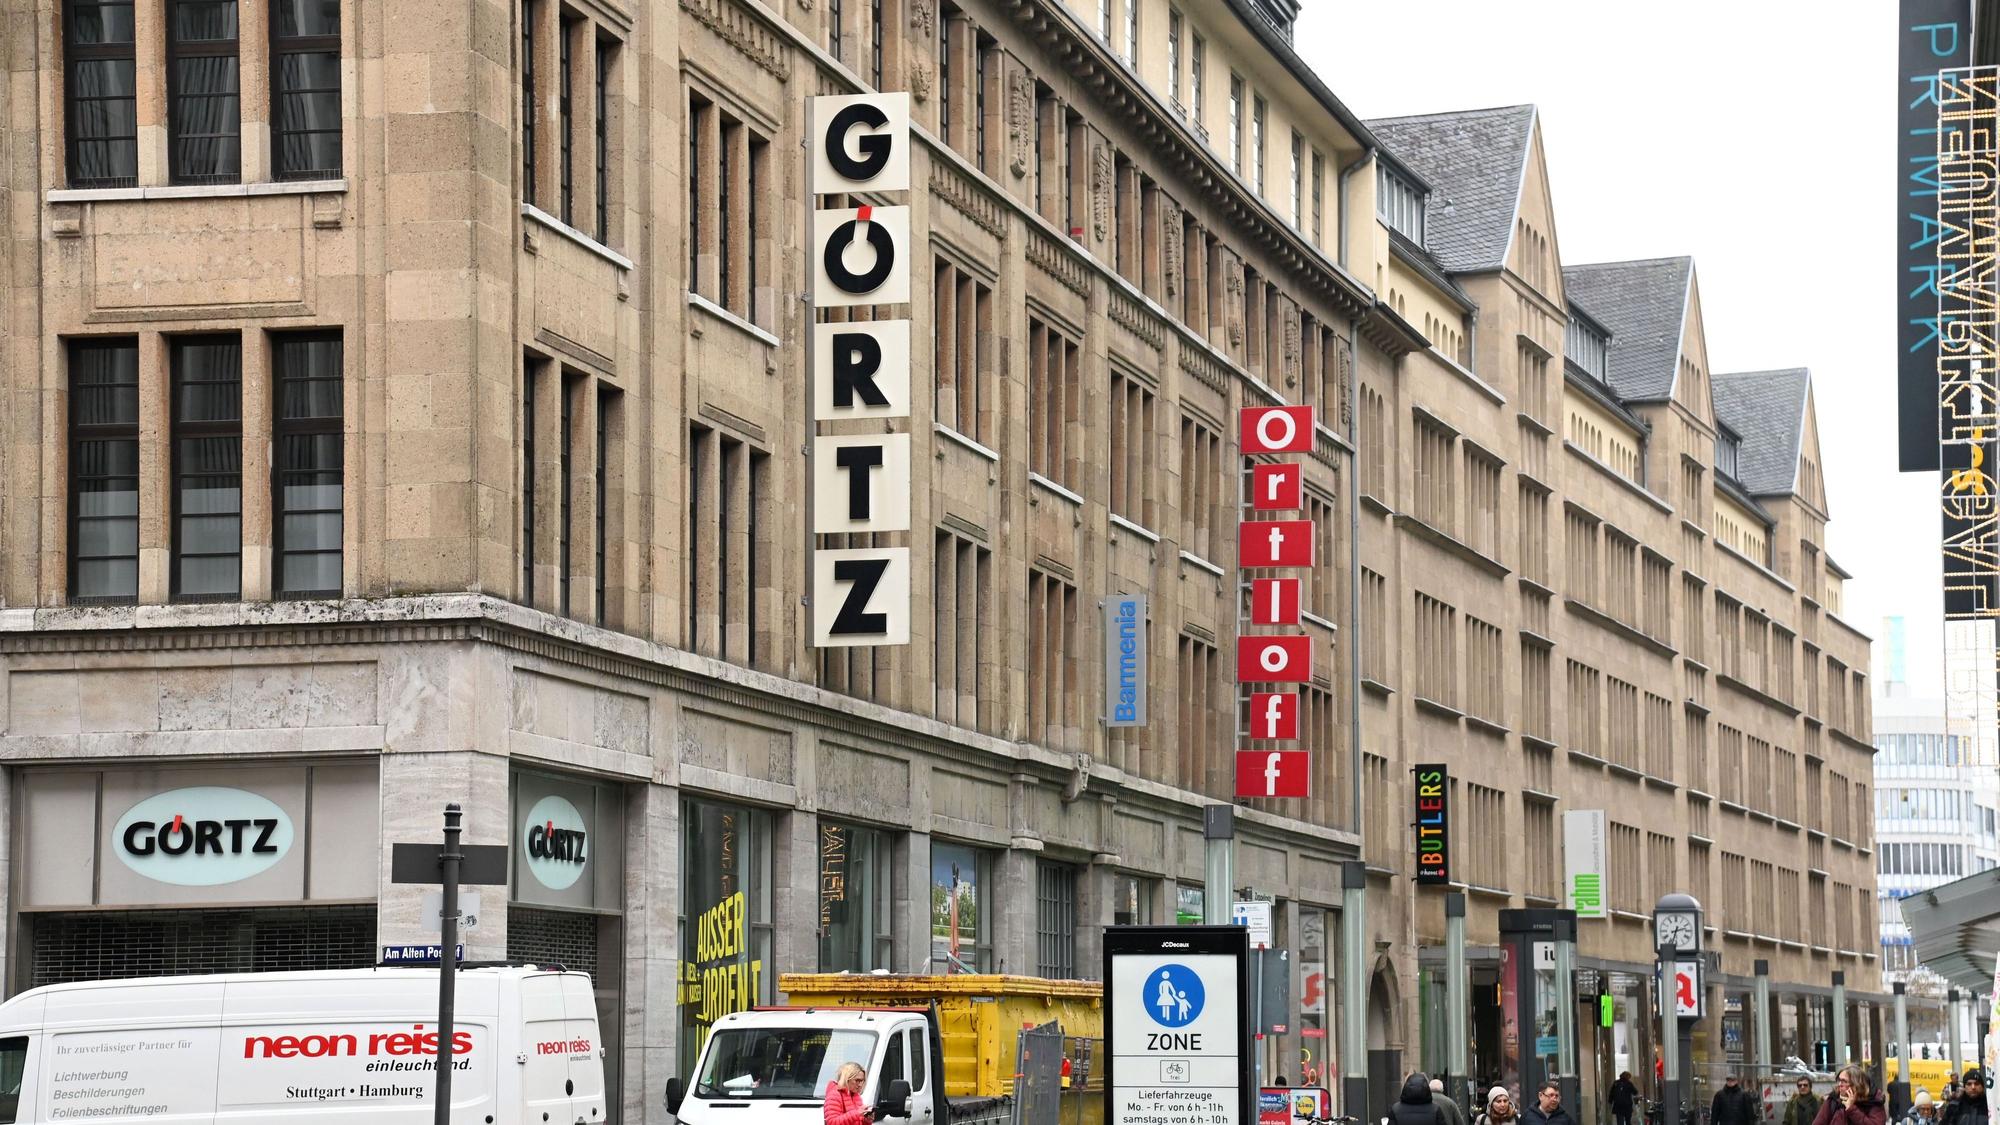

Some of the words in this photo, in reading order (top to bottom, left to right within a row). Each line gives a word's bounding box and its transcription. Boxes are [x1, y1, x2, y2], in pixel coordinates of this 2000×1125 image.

[1910, 22, 1958, 352] PRIMARK
[1114, 601, 1136, 721] Barmenia
[1420, 771, 1443, 864] BUTLERS
[1570, 874, 1600, 914] rahm
[697, 891, 744, 963] AUSSER
[385, 948, 399, 959] Am
[402, 947, 424, 958] Alten
[57, 1045, 71, 1055] Ihr
[74, 1042, 136, 1054] zuverlässiger
[138, 1041, 176, 1051] Partner
[178, 1039, 192, 1049] für
[244, 1034, 357, 1058] neon
[368, 1024, 473, 1056] reiss
[537, 1040, 567, 1054] neon
[569, 1038, 590, 1053] reiss
[1147, 1033, 1202, 1051] ZONE
[366, 1058, 472, 1072] einleuchtnd.
[54, 1070, 129, 1082] Lichtwerbung
[53, 1087, 145, 1100] Beschilderungen
[286, 1085, 346, 1100] Stuttgart
[359, 1084, 423, 1099] Hamburg
[1138, 1091, 1213, 1101] Lieferfahrzeuge
[52, 1104, 168, 1118] Folienbeschriftungen
[1127, 1103, 1143, 1111] Mo.
[1154, 1103, 1165, 1111] Fr.
[1123, 1115, 1168, 1125] samstags
